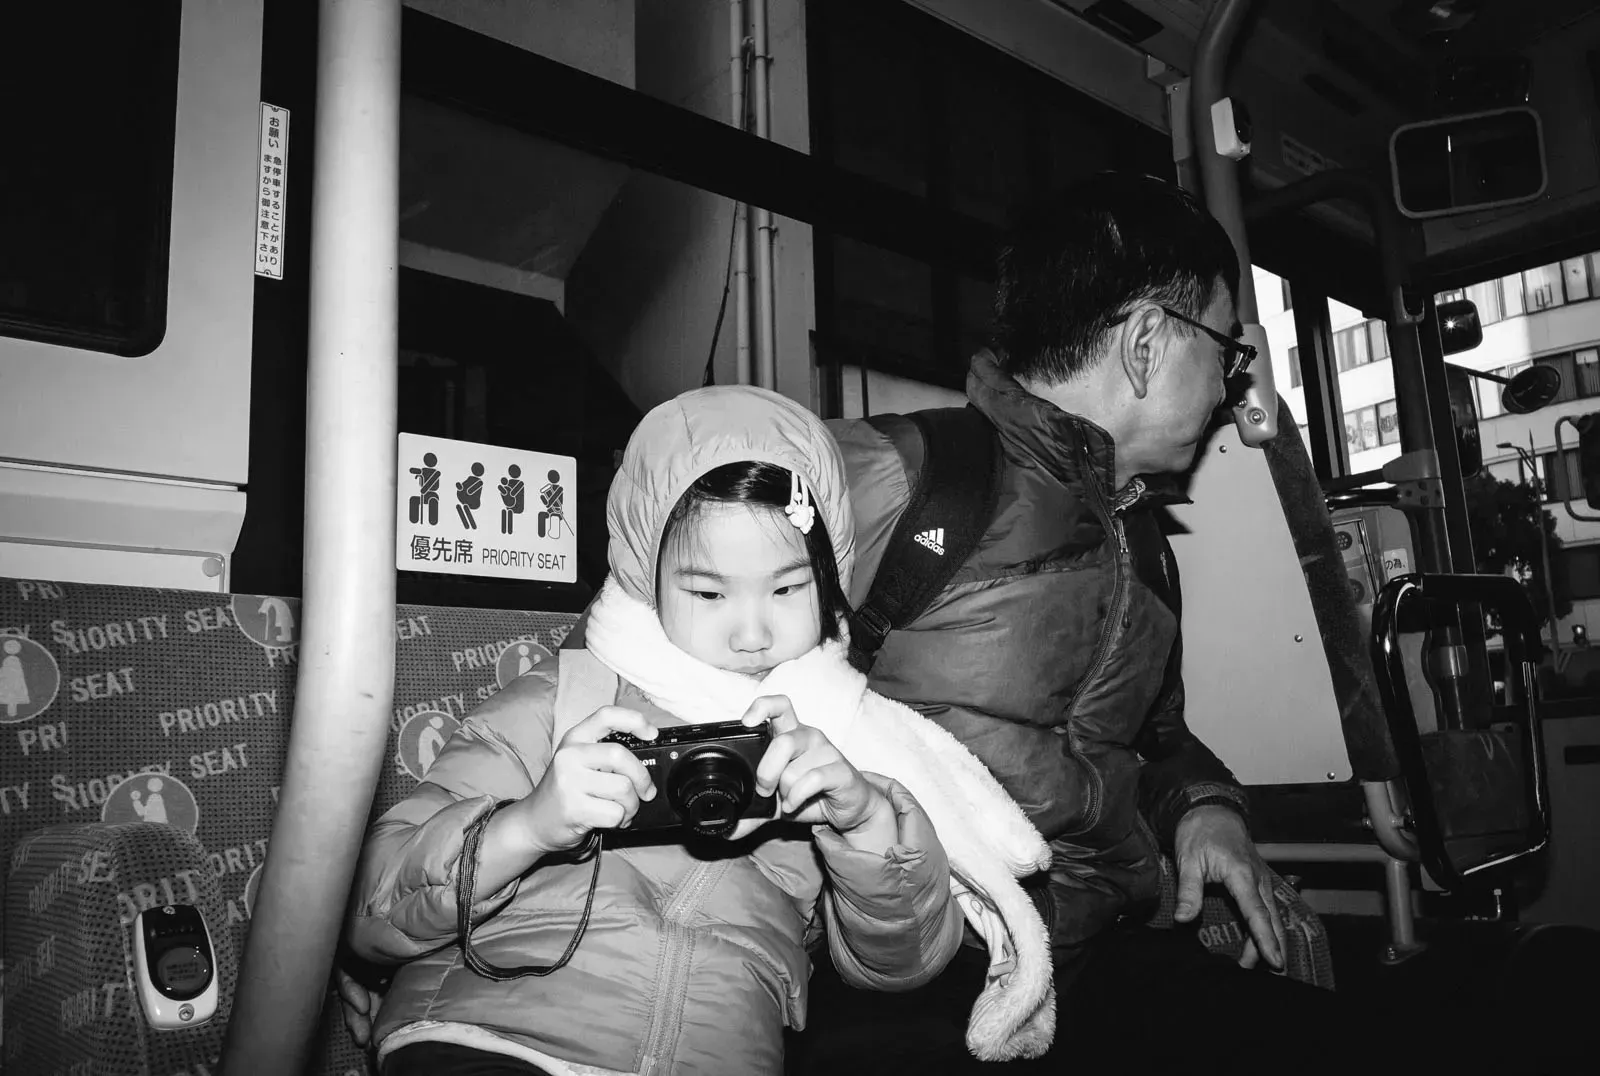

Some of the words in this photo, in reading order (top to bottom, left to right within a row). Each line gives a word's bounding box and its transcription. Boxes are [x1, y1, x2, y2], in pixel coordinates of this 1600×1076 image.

[268, 117, 280, 149] お願い
[258, 154, 273, 263] ますから御注意下さい
[269, 156, 282, 266] 急停車することがあり
[410, 534, 474, 565] 優先席
[482, 548, 535, 568] PRIORITY
[537, 552, 567, 571] SEAT
[914, 534, 945, 556] adidas
[184, 605, 233, 633] SEA
[396, 615, 431, 641] EAT
[70, 667, 135, 702] SEAT
[159, 690, 278, 737] PRIORITY
[189, 743, 248, 779] SEAT
